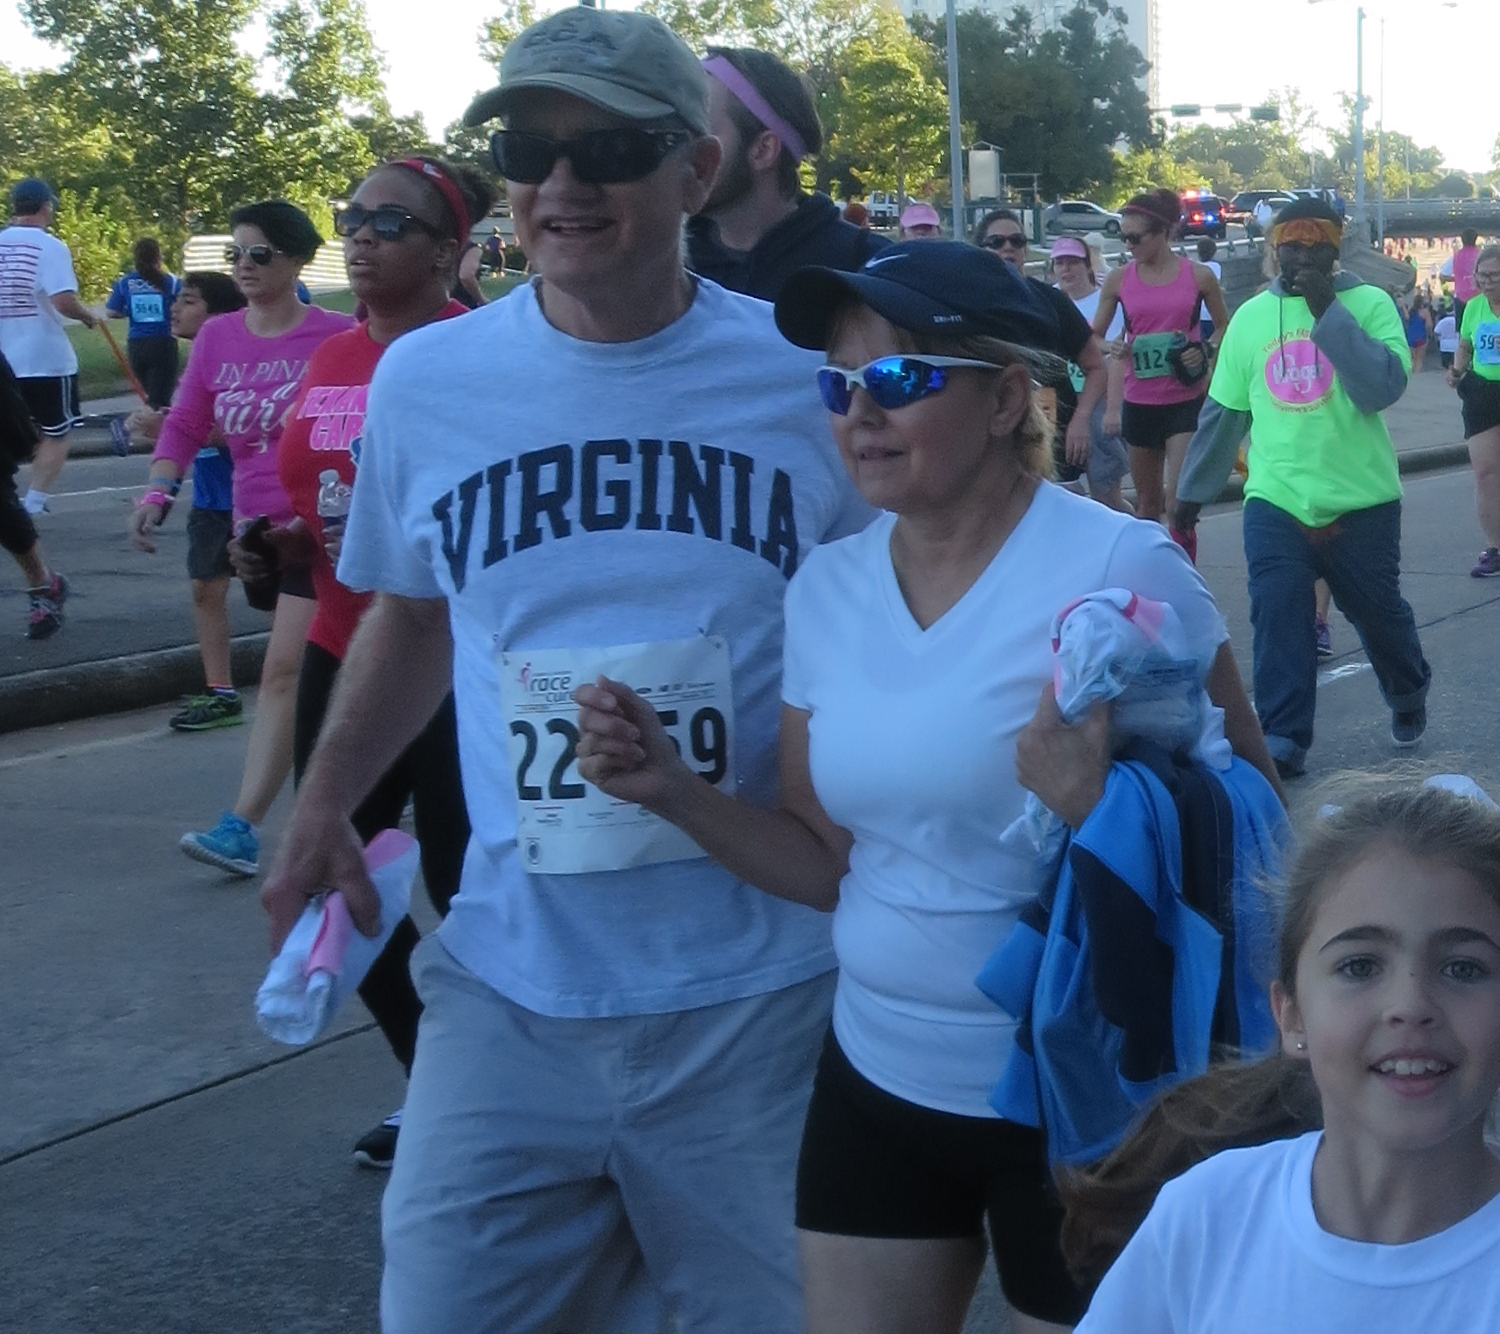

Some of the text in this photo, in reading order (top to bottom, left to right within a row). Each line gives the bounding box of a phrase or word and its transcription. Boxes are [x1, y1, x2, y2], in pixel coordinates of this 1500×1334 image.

[1480, 334, 1495, 350] 59
[215, 362, 248, 385] IN
[296, 384, 369, 420] TEXAN
[310, 414, 366, 451] CAR
[432, 438, 799, 594] VIRGINIA
[530, 675, 572, 692] race
[509, 707, 727, 801] 229
